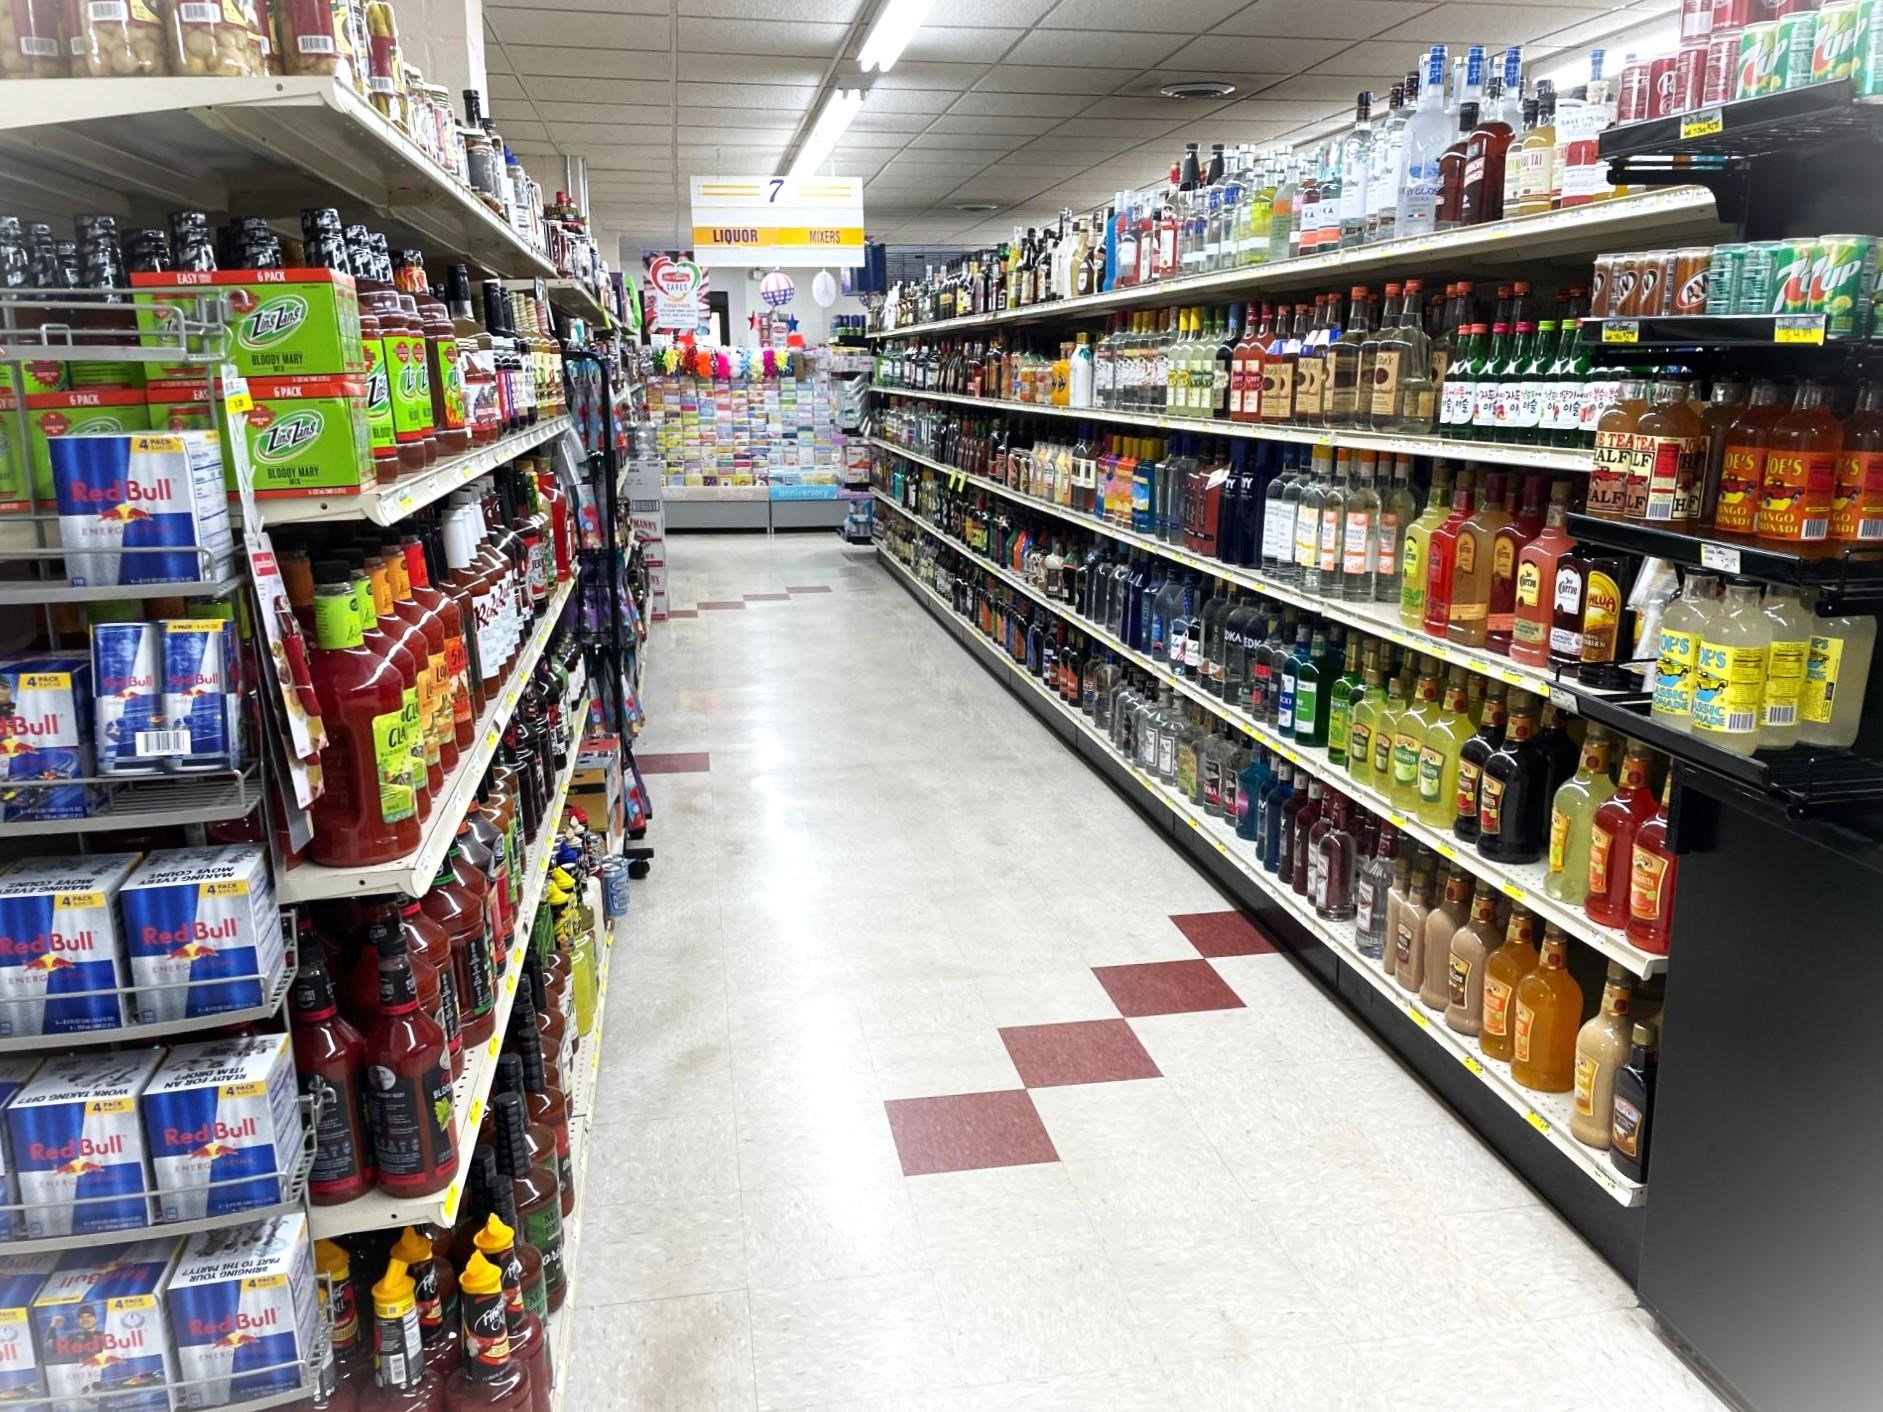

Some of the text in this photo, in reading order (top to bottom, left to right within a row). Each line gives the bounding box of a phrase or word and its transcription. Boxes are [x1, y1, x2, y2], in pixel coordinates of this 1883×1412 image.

[768, 178, 785, 204] 7
[713, 229, 841, 244] LIQUOR MIXERS
[177, 273, 197, 285] EASY
[257, 271, 286, 282] 6 PACK
[666, 283, 688, 291] CARES
[251, 352, 304, 365] BLOODY MARY
[193, 389, 210, 400] EAS
[274, 386, 302, 397] 6 PACK
[77, 394, 100, 405] PACK
[1523, 399, 1537, 414] 이슬
[1563, 402, 1581, 417] 이슬
[139, 438, 171, 450] 4 PACK
[1608, 433, 1635, 449] TEA
[1633, 452, 1652, 467] LF
[1726, 453, 1755, 470] OE'S
[267, 466, 320, 479] BLOODY MARY
[1769, 457, 1803, 476] OE'S
[70, 478, 172, 501] Red Bull
[1627, 494, 1646, 509] LF
[82, 527, 128, 537] ENERG
[1519, 574, 1537, 589] Cuervo
[1557, 581, 1578, 595] Cuervo
[1660, 634, 1690, 656] OE'S
[27, 675, 59, 687] 4 PACK
[128, 676, 153, 688] Bull
[195, 673, 219, 685] Bull
[13, 713, 59, 736] Bull
[197, 866, 235, 874] MOVE
[182, 872, 235, 882] MAKING
[207, 885, 217, 895] 4
[61, 897, 71, 906] 4
[142, 918, 238, 946] Red Bull
[0, 930, 93, 956] Red Bull
[152, 962, 192, 974] ENERG
[8, 972, 50, 985] ENERG
[215, 1066, 244, 1075] ITEM
[164, 1080, 183, 1089] AN
[195, 1076, 216, 1085] FOR
[48, 1090, 91, 1100] TAKING
[93, 1088, 128, 1097] WORK
[225, 1086, 235, 1096] 4
[93, 1103, 102, 1112] 4
[164, 1117, 257, 1147] Red Bull
[29, 1134, 123, 1161] Red Bull
[40, 1176, 76, 1188] ENERG
[182, 1264, 219, 1276] PARTY?
[222, 1262, 239, 1270] THE
[59, 1272, 101, 1289] Bull
[188, 1266, 268, 1283] BRINGING YOUR
[248, 1279, 257, 1289] 4
[115, 1300, 124, 1309] 4
[189, 1307, 277, 1336] Red Bull
[55, 1329, 144, 1354] Red Bull
[199, 1351, 236, 1361] ENERG
